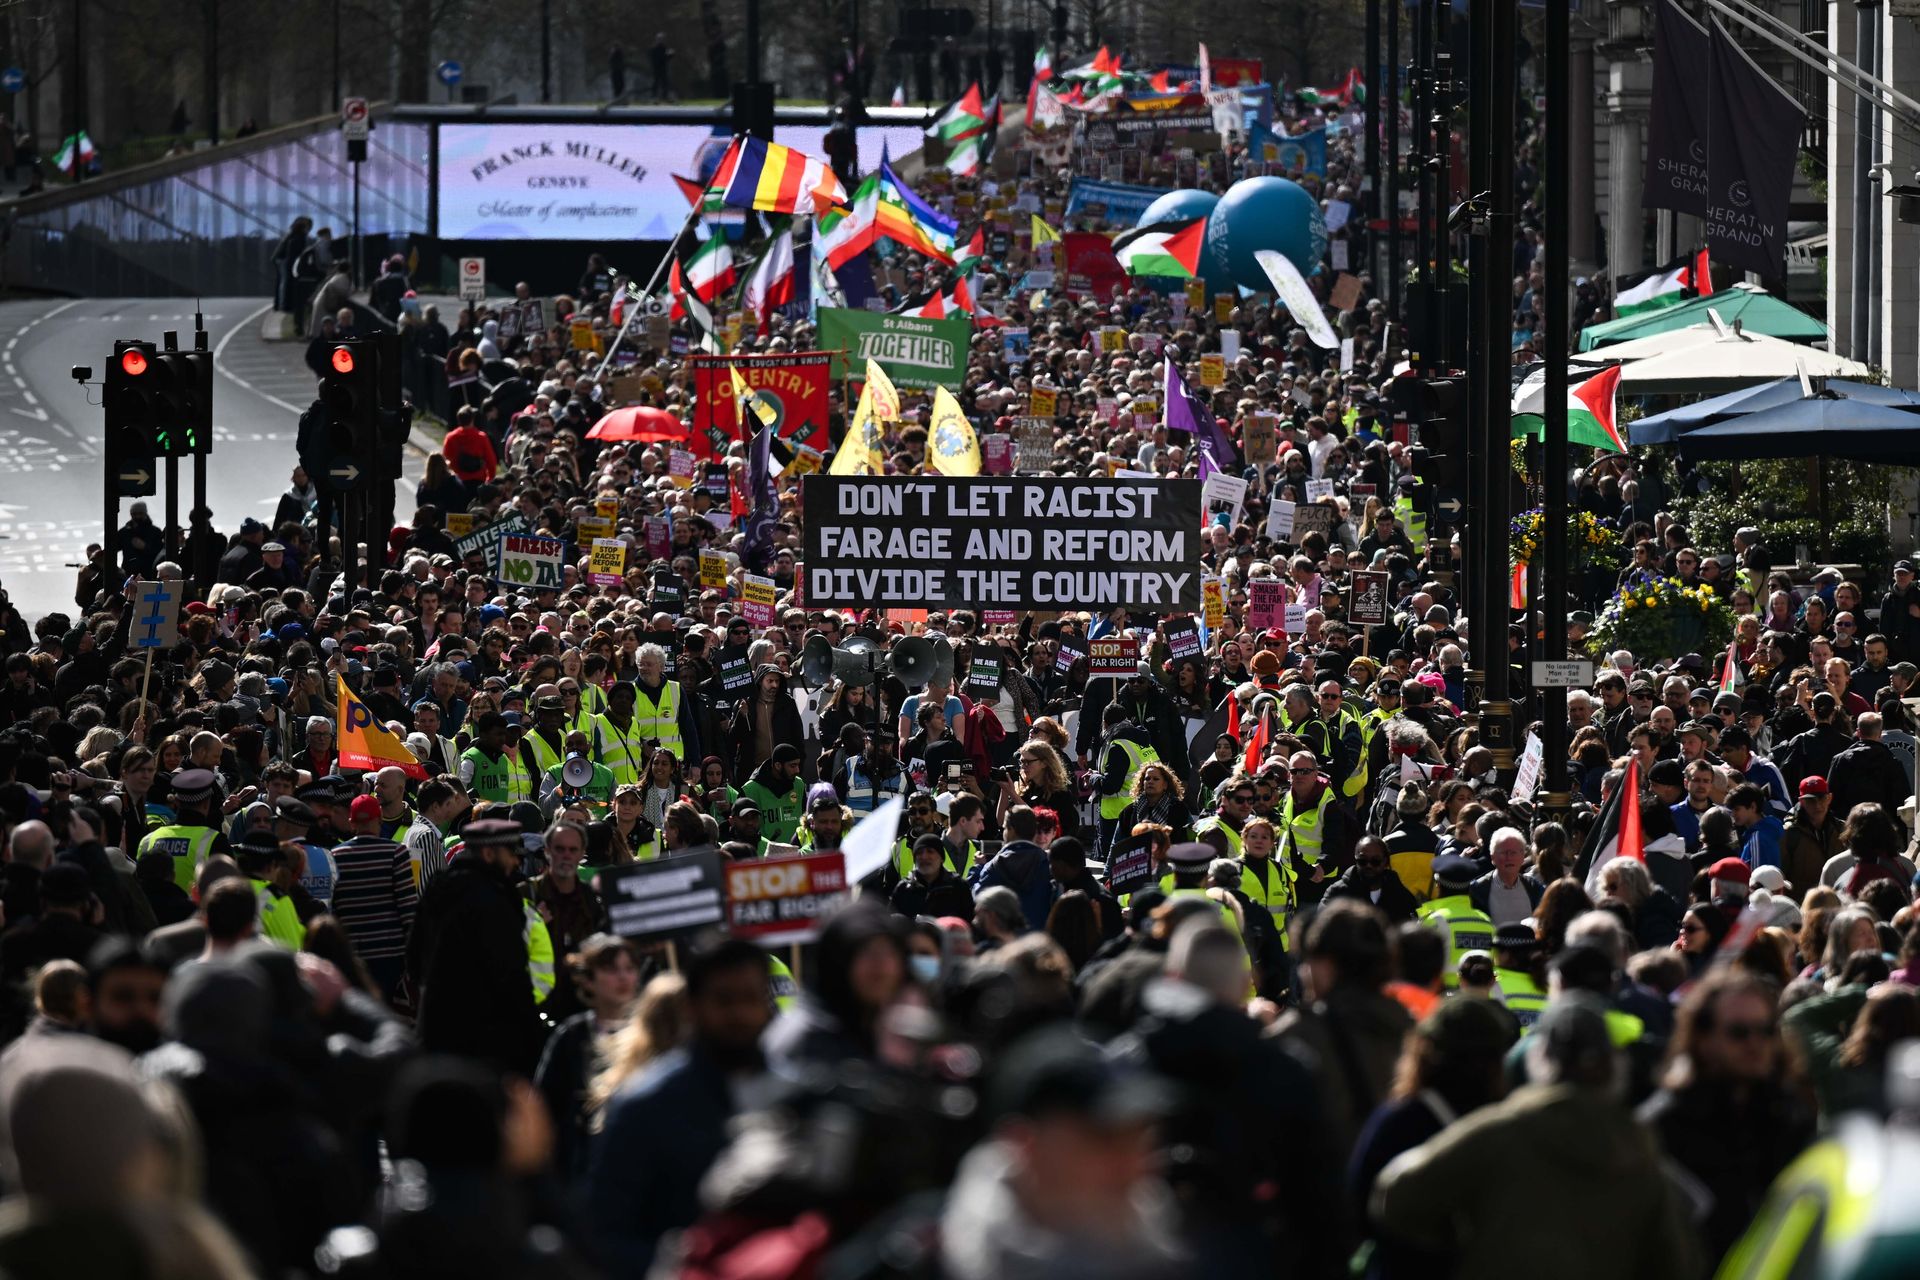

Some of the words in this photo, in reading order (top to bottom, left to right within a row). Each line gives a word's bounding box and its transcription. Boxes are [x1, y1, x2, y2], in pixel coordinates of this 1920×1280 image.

[471, 141, 553, 181] FRANCK
[565, 141, 649, 183] MULLER
[477, 200, 533, 218] Master
[538, 200, 556, 223] of
[1706, 206, 1774, 238] HERATN
[1706, 222, 1762, 247] GRAND
[883, 318, 895, 328] St
[896, 320, 934, 333] Albans
[859, 334, 954, 367] TOGETHER
[838, 483, 936, 516] DON'T
[947, 485, 1013, 517] LET
[1024, 486, 1159, 518] RACIST
[457, 525, 500, 553] UNITE
[820, 526, 953, 559] FARAGE
[964, 528, 1032, 560] AND
[1043, 529, 1185, 562] REFORM
[592, 559, 621, 567] REFORM
[705, 557, 720, 565] STOP
[504, 558, 533, 583] NO
[702, 564, 722, 572] RACIST
[702, 571, 724, 579] REFORM
[745, 583, 774, 596] Refugees
[812, 568, 945, 600] DIVIDE
[957, 569, 1021, 601] THE
[1032, 571, 1191, 604] COUNTRY
[1253, 584, 1278, 594] SMASH
[745, 592, 772, 603] welcome
[1253, 594, 1268, 603] THE
[1269, 595, 1282, 604] FAR
[744, 601, 758, 611] Stop
[759, 604, 770, 613] the
[1253, 603, 1275, 613] RIGHT
[743, 609, 753, 618] far
[753, 611, 769, 622] right
[1180, 629, 1193, 637] ARE
[1061, 645, 1070, 653] WE
[1090, 643, 1121, 656] STOP
[1123, 648, 1135, 656] THE
[1172, 644, 1193, 653] AGAINST
[1184, 648, 1200, 657] RIGHT
[721, 662, 734, 670] WE
[735, 658, 746, 667] ARE
[974, 658, 984, 666] WE
[984, 659, 997, 667] ARE
[1091, 658, 1107, 667] FAR
[1109, 658, 1135, 667] RIGHT
[1557, 663, 1580, 671] loading
[724, 682, 736, 690] FAR
[737, 678, 753, 688] RIGHT
[970, 678, 981, 686] FAR
[482, 775, 499, 789] FOA
[1115, 852, 1128, 864] WE
[1129, 846, 1146, 858] ARE
[729, 864, 809, 899] STOP
[1112, 875, 1126, 886] FAR
[1126, 868, 1148, 880] RIGHT
[733, 903, 775, 923] FAR
